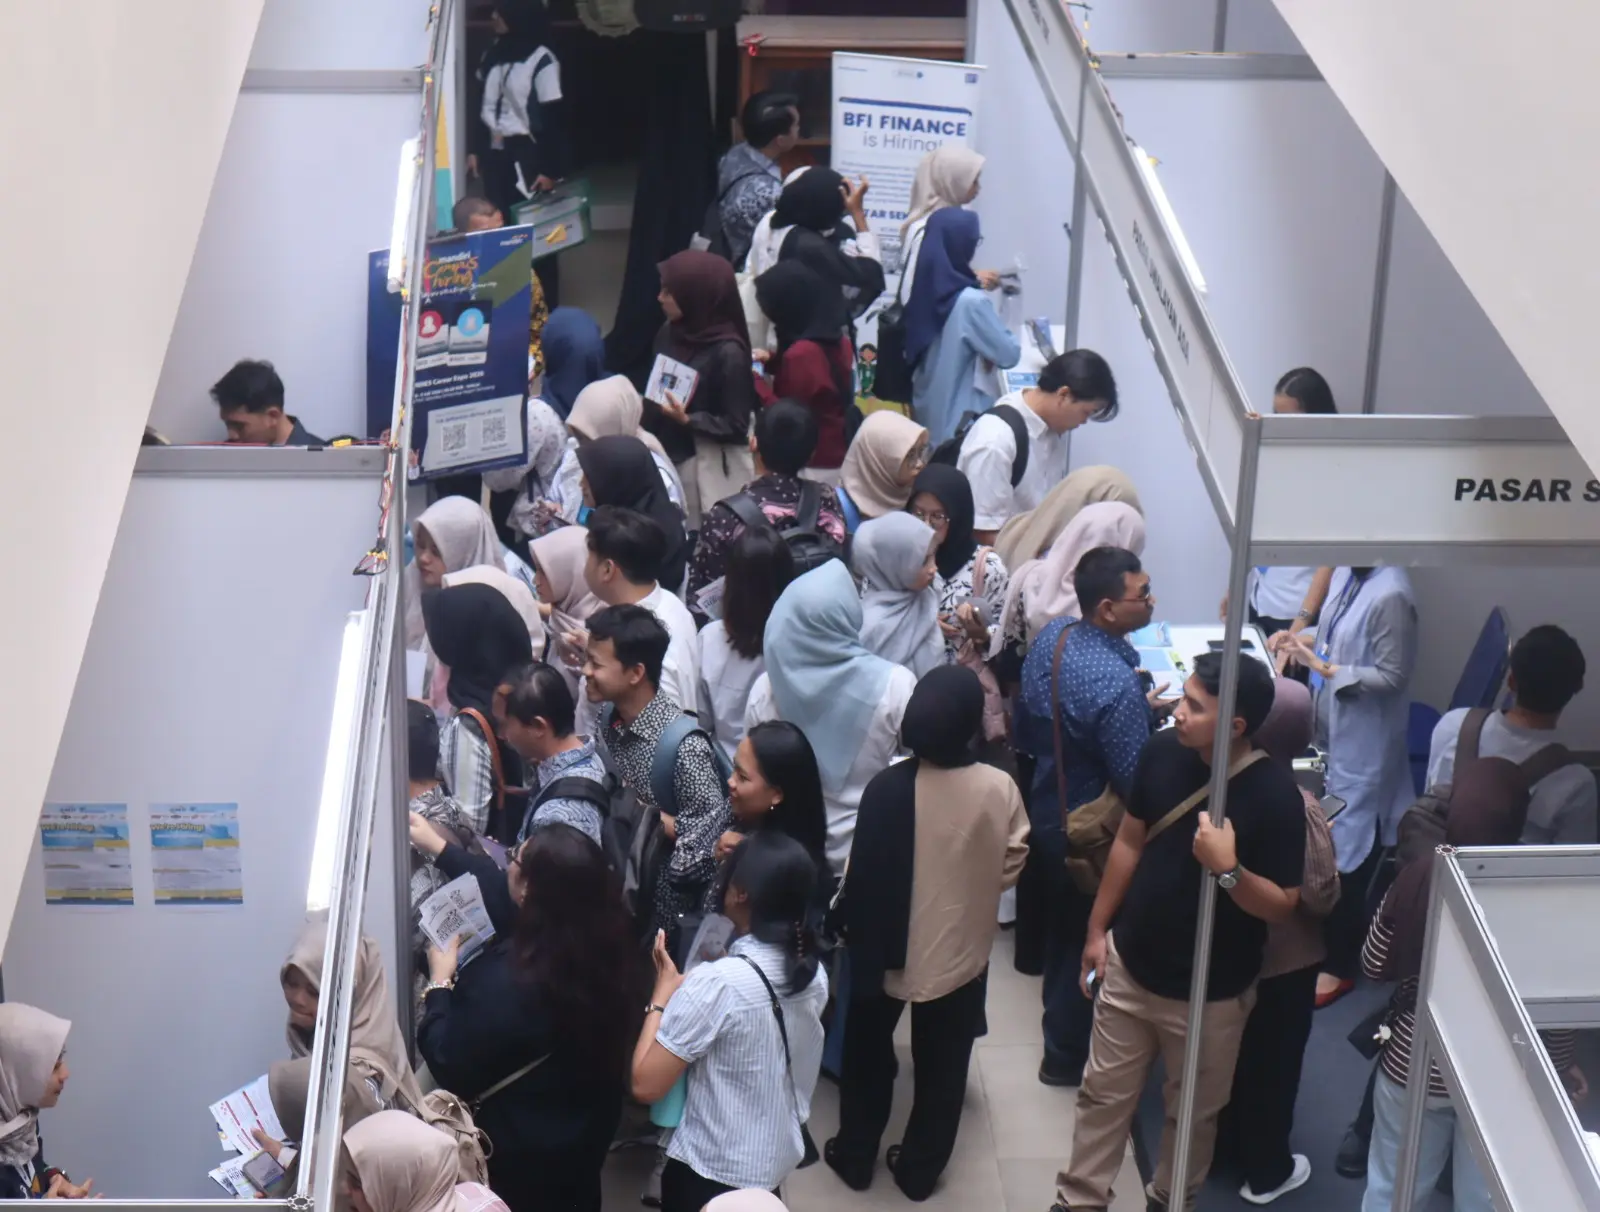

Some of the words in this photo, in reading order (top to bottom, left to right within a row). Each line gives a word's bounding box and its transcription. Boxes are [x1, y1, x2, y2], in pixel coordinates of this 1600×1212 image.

[843, 111, 872, 128] BFI
[880, 115, 967, 137] FINANCE
[862, 132, 878, 148] is
[1454, 478, 1572, 502] PASAR
